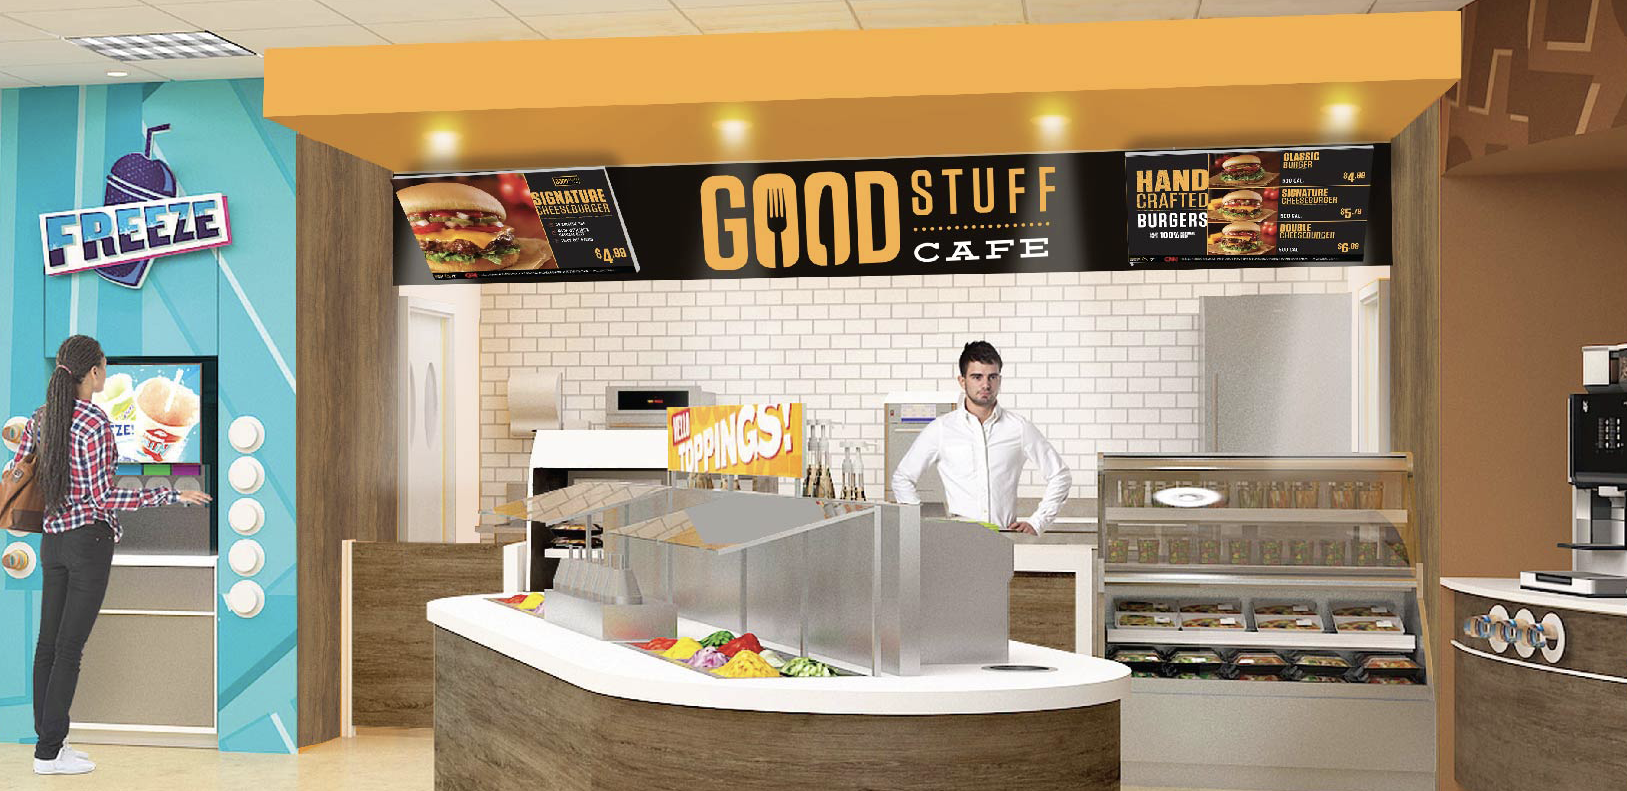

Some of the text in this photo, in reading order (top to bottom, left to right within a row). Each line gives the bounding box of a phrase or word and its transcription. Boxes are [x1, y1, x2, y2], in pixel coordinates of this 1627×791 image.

[1283, 152, 1319, 161] CLASSIC
[1283, 161, 1313, 169] BURGER
[1136, 169, 1208, 193] HAND
[530, 189, 607, 206] SIGNATURE
[1136, 193, 1208, 209] CRAFTED
[1281, 188, 1329, 197] SIGNATURE
[1281, 197, 1338, 205] CHEESEBURGER
[536, 203, 611, 216] CHEESEBURGER
[700, 166, 1056, 271] GOOD STUFF
[1137, 212, 1208, 229] BURGERS
[45, 200, 221, 268] FREEZE
[1280, 223, 1312, 232] DOUBLE
[914, 237, 1049, 263] CAFE
[672, 411, 690, 444] HELLO
[678, 403, 793, 472] TOPPINGS!
